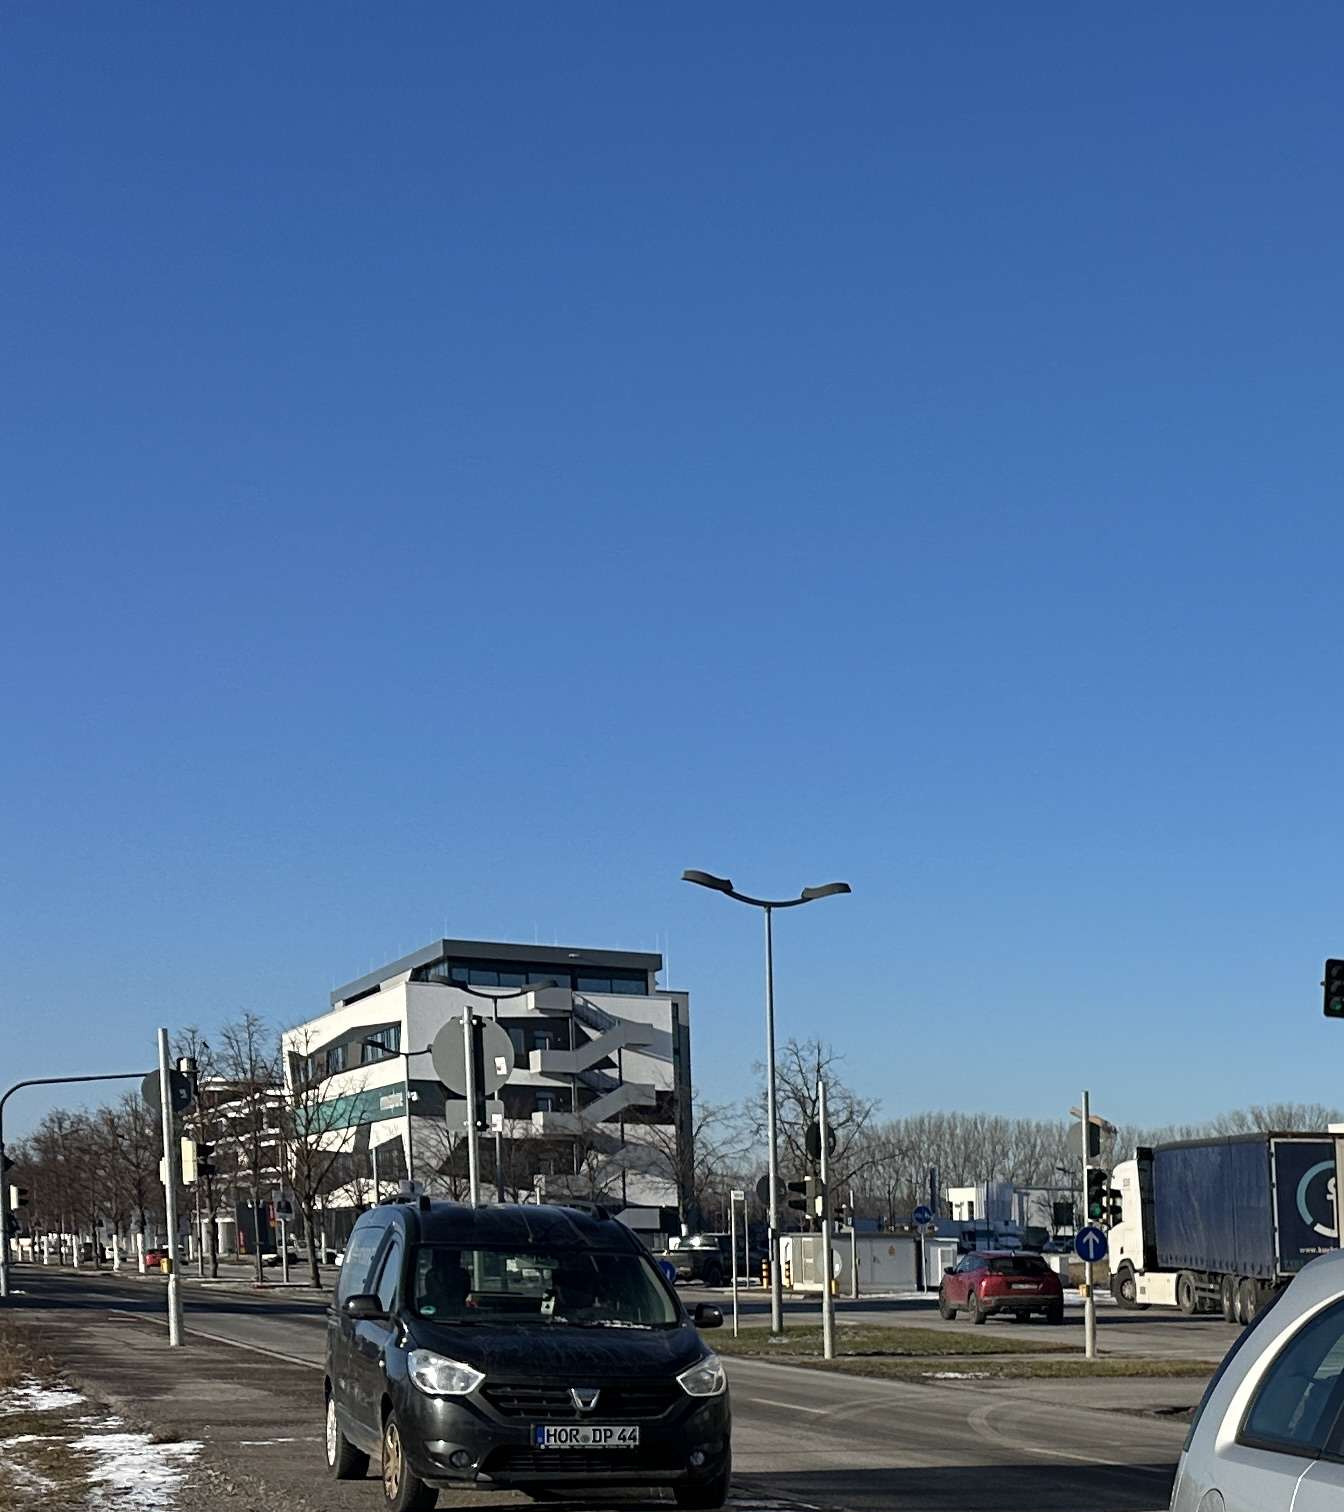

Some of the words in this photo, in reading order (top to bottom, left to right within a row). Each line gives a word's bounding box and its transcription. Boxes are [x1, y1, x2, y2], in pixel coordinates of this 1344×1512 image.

[546, 1428, 580, 1443] HOR
[591, 1428, 613, 1443] DP
[617, 1428, 637, 1443] 44
